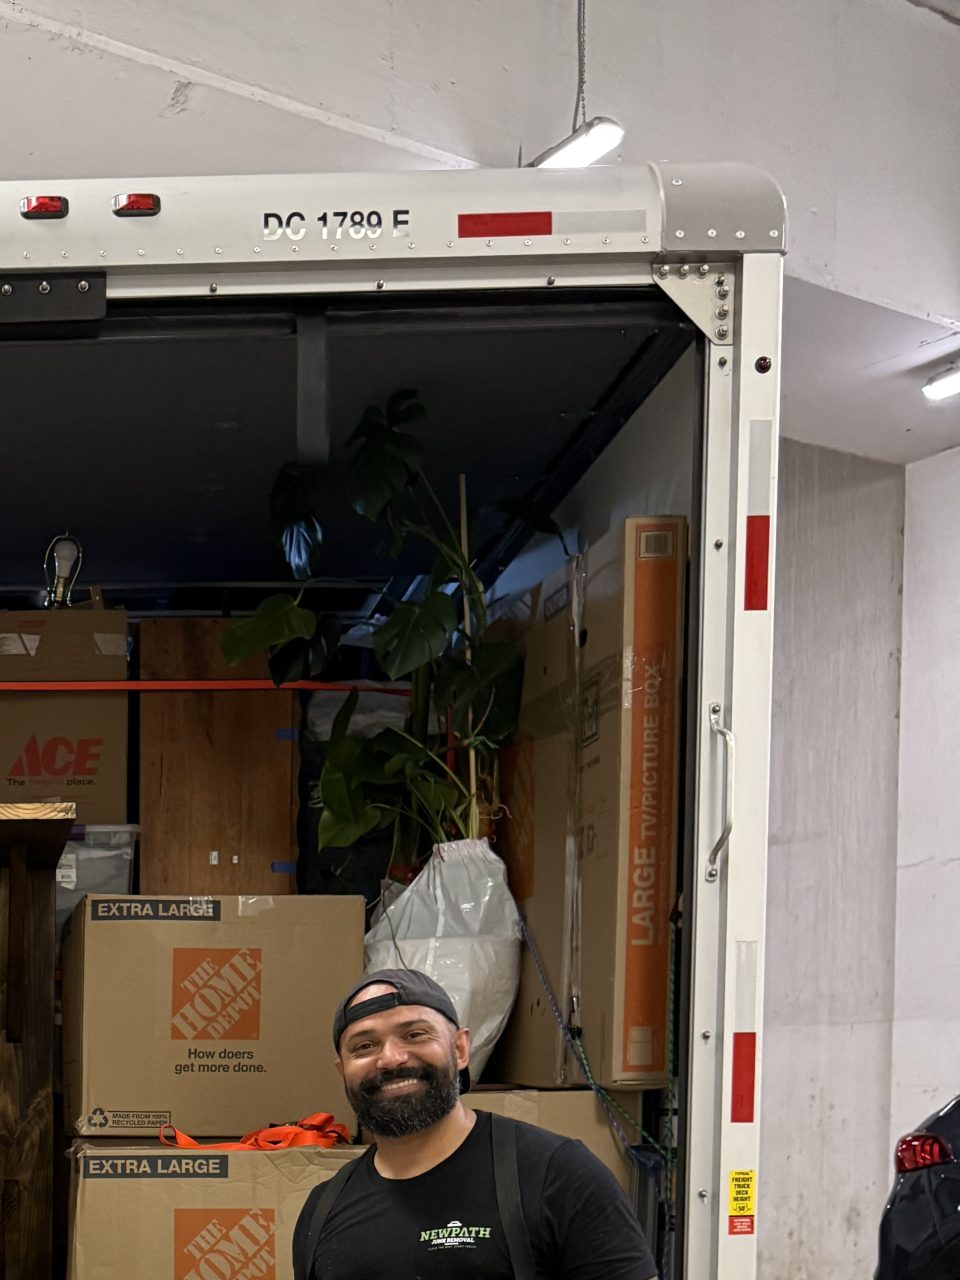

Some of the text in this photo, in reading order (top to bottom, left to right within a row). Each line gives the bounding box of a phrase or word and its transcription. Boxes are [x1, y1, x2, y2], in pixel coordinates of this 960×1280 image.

[263, 211, 306, 241] DC
[316, 210, 382, 240] 1789
[8, 732, 104, 777] ACE
[631, 663, 660, 946] LARGE TV/PICTURE BOX
[97, 903, 214, 917] EXTRA LARGE
[181, 956, 218, 993] THE
[171, 949, 262, 1041] HOME
[206, 982, 261, 1040] DEPOT
[174, 1062, 267, 1075] get more done.
[188, 1048, 254, 1060] How doers
[89, 1160, 221, 1174] EXTRA LARGE
[184, 1218, 227, 1260] THE
[420, 1226, 491, 1242] NEWPATH
